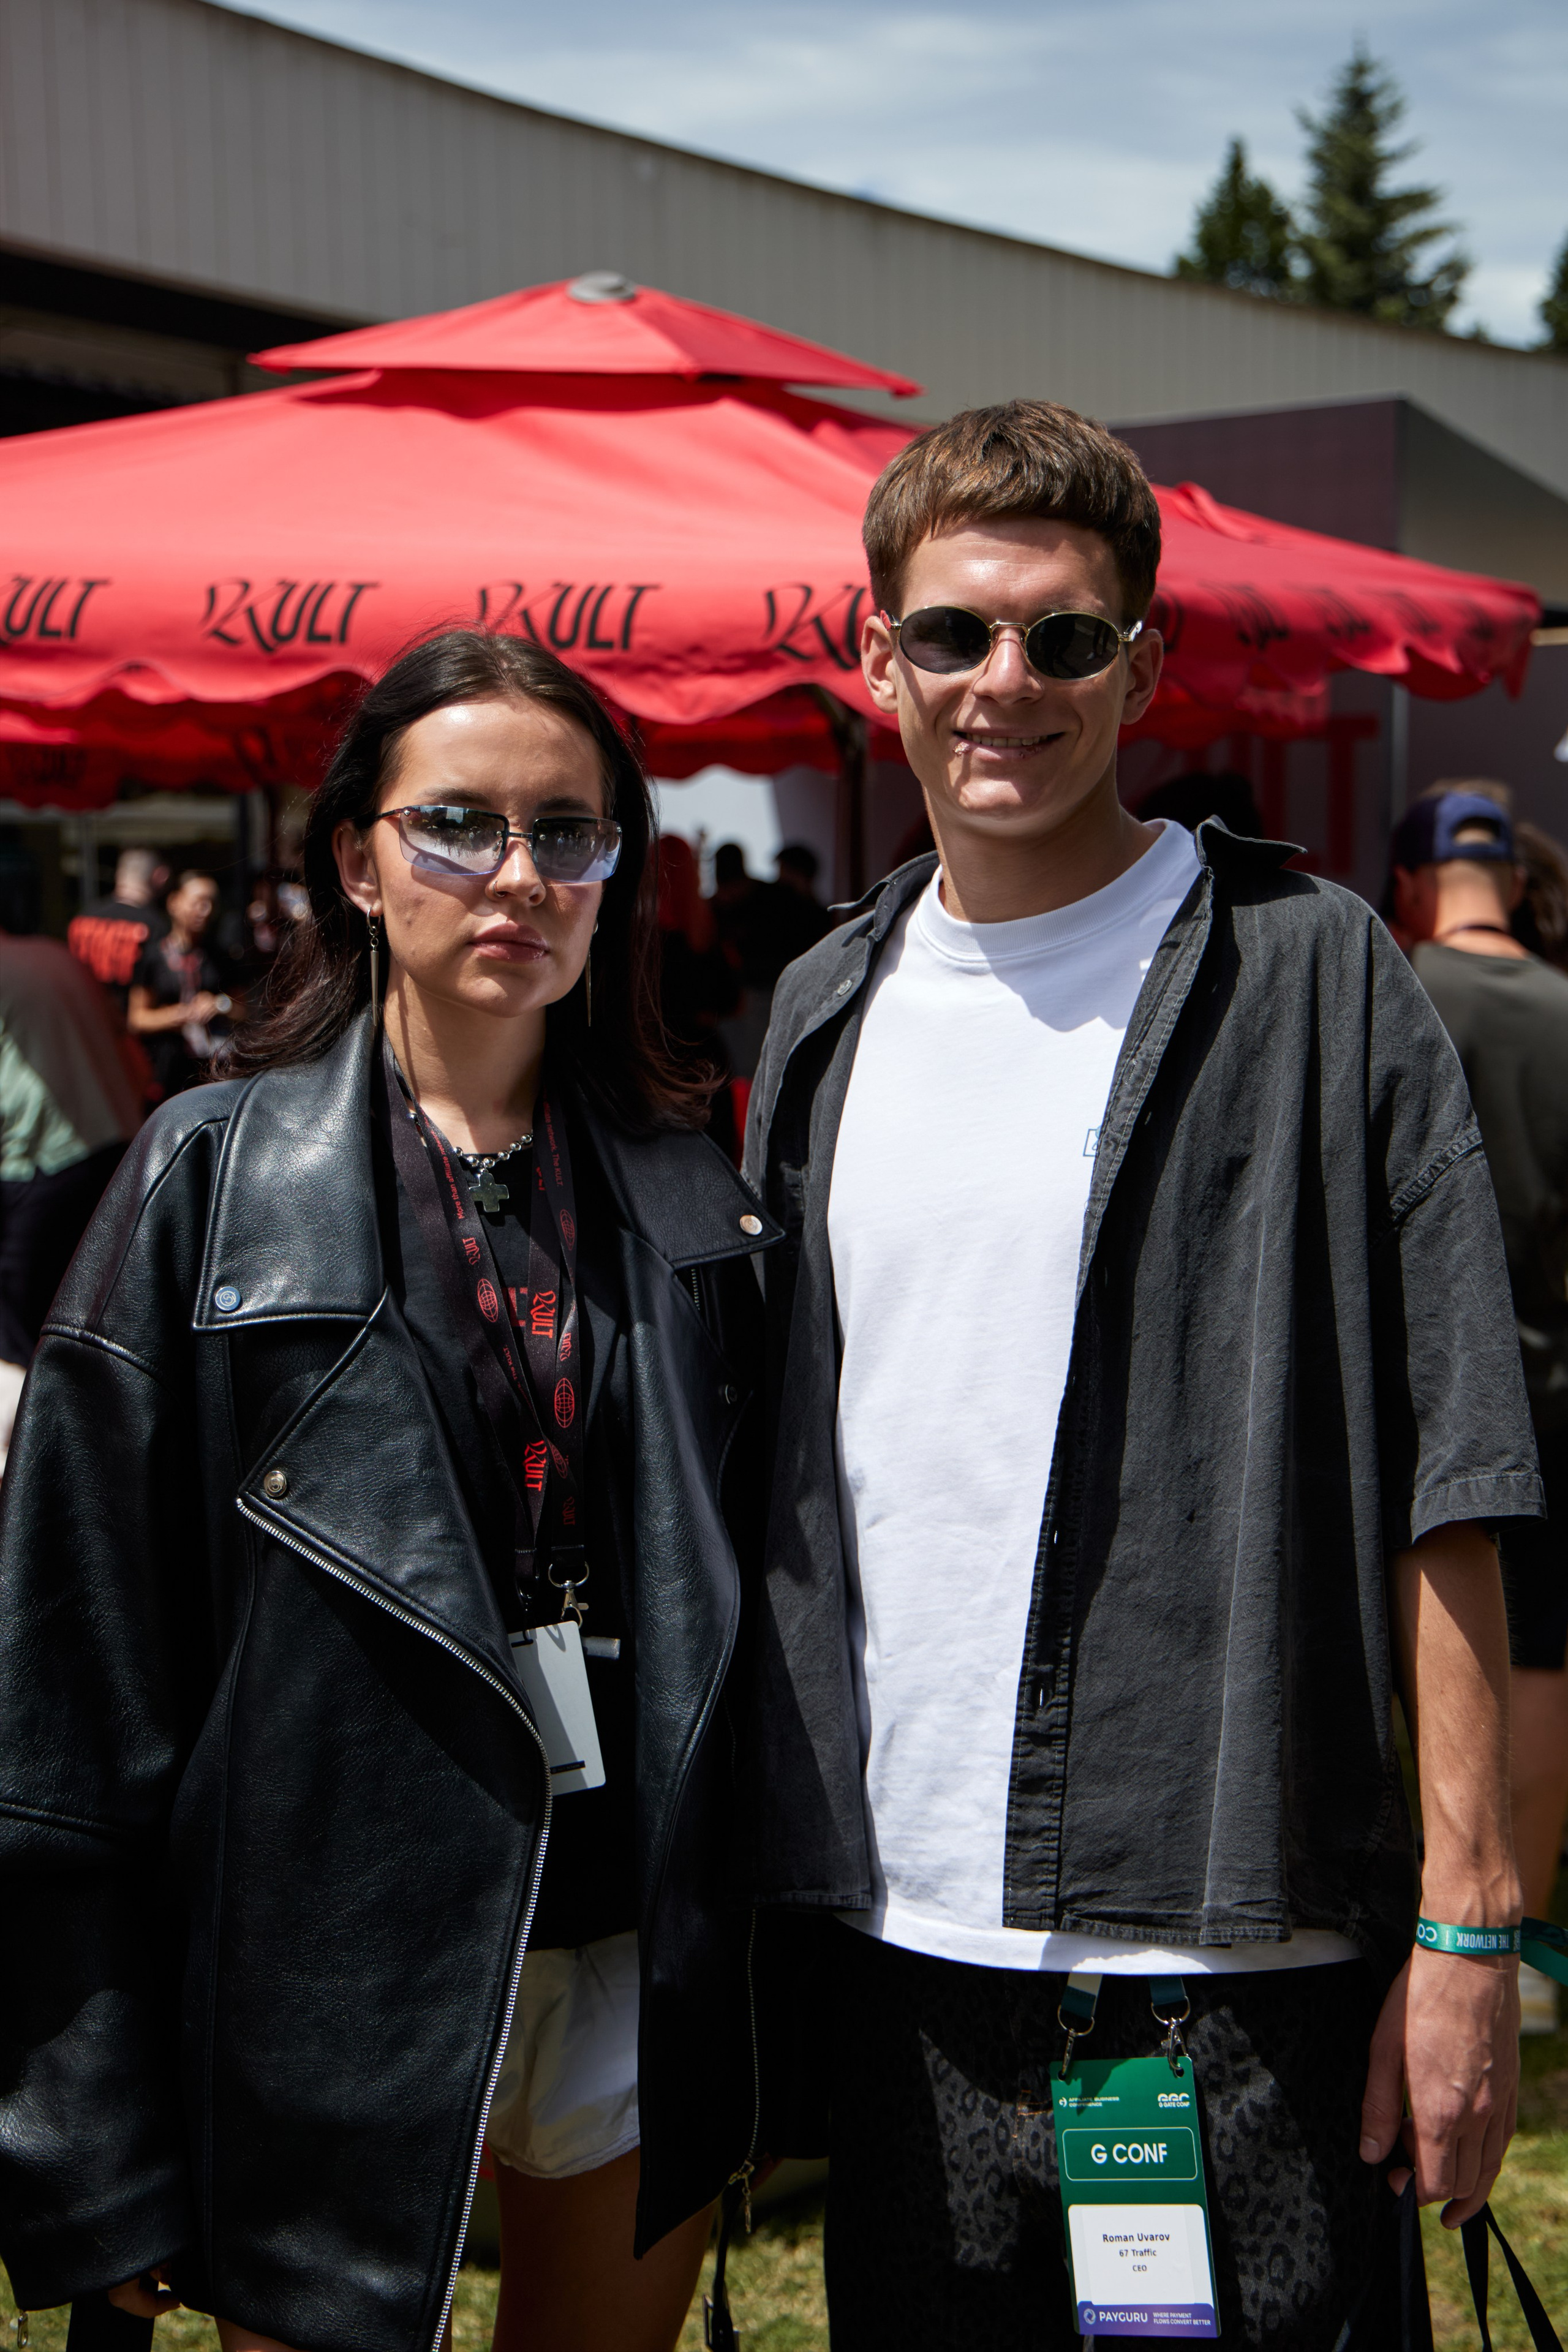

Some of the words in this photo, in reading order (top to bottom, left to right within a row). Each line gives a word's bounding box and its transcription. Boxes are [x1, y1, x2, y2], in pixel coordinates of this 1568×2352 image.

[442, 1156, 454, 1183] affiliate
[450, 1183, 459, 1200] than
[455, 1200, 465, 1219] More
[530, 1290, 556, 1339] KULT
[1416, 1923, 1438, 1942] CO
[1456, 1932, 1498, 1949] NETWORK
[1498, 1934, 1510, 1949] THE
[1090, 2143, 1108, 2164] G
[1112, 2143, 1168, 2164] CONF
[1102, 2234, 1134, 2242] Roman
[1137, 2233, 1170, 2242] Uvarov
[1099, 2311, 1148, 2323] PAYGURU
